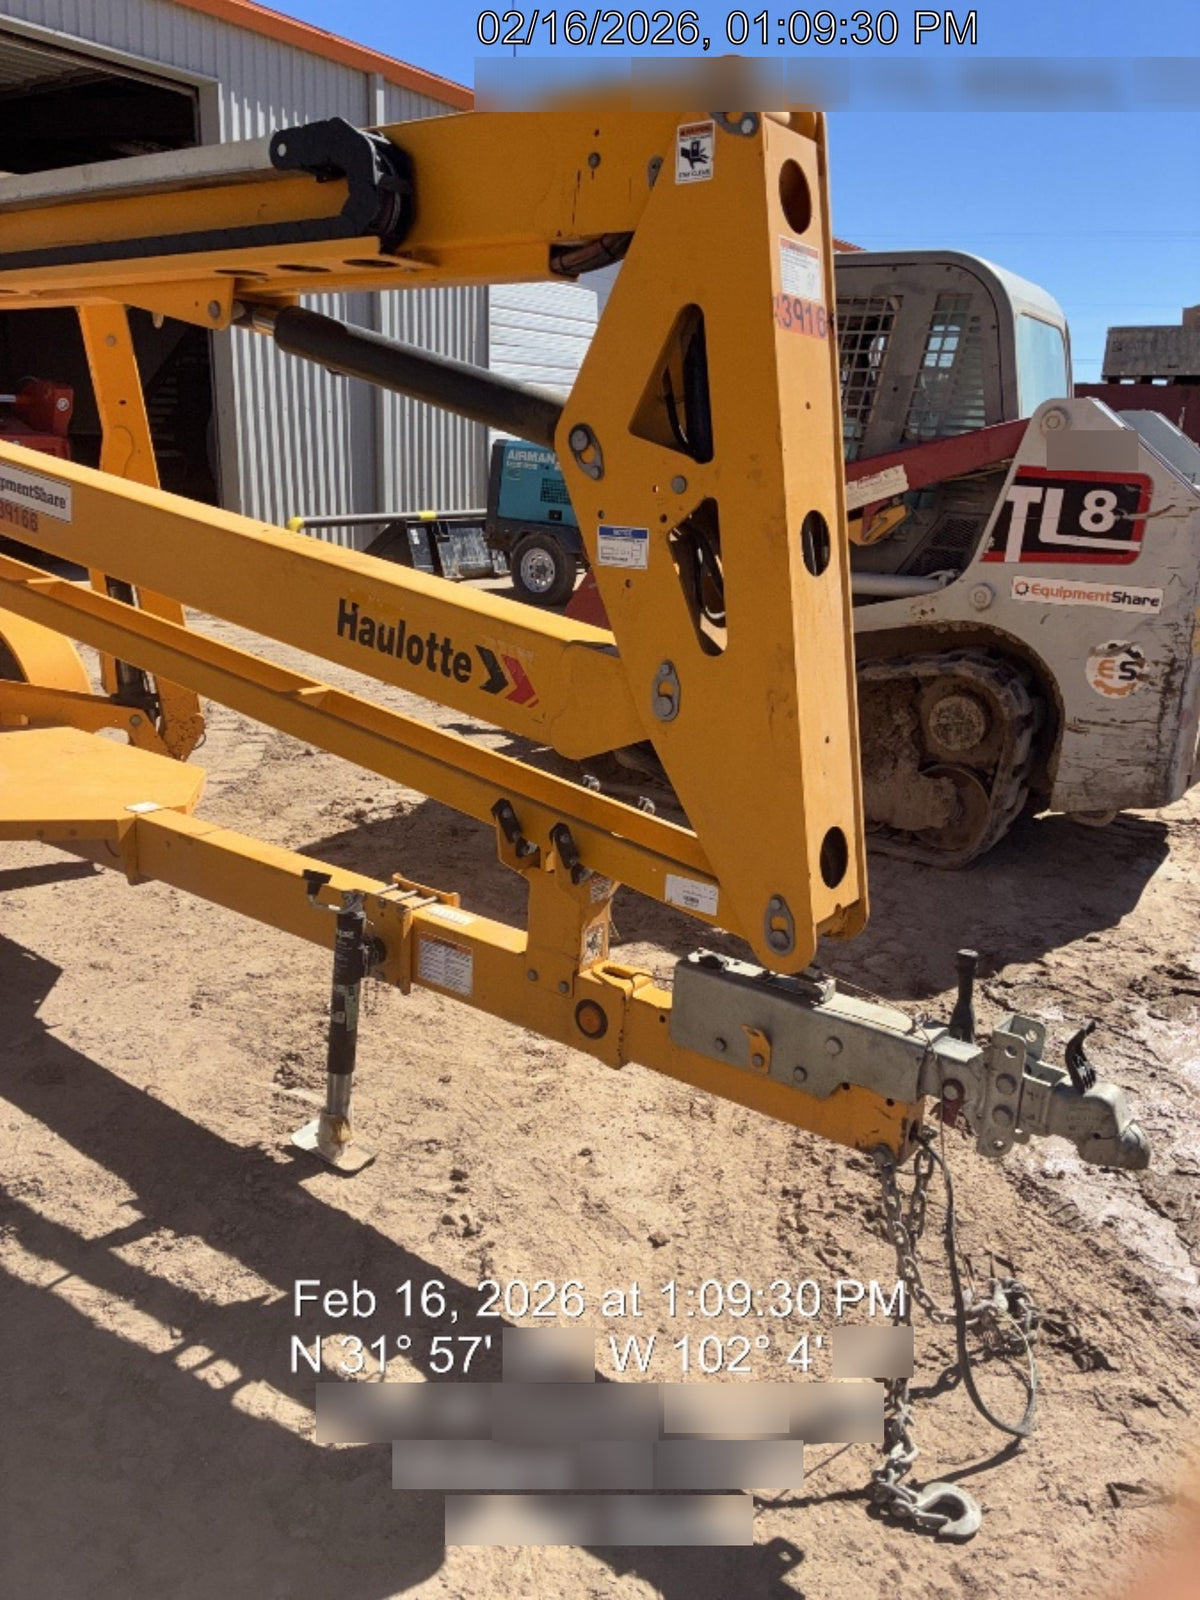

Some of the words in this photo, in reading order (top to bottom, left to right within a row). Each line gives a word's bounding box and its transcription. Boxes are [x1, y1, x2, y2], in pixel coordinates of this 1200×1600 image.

[1030, 583, 1161, 607] EquipmentShare
[336, 598, 473, 683] Haulotte
[1096, 658, 1137, 681] ES
